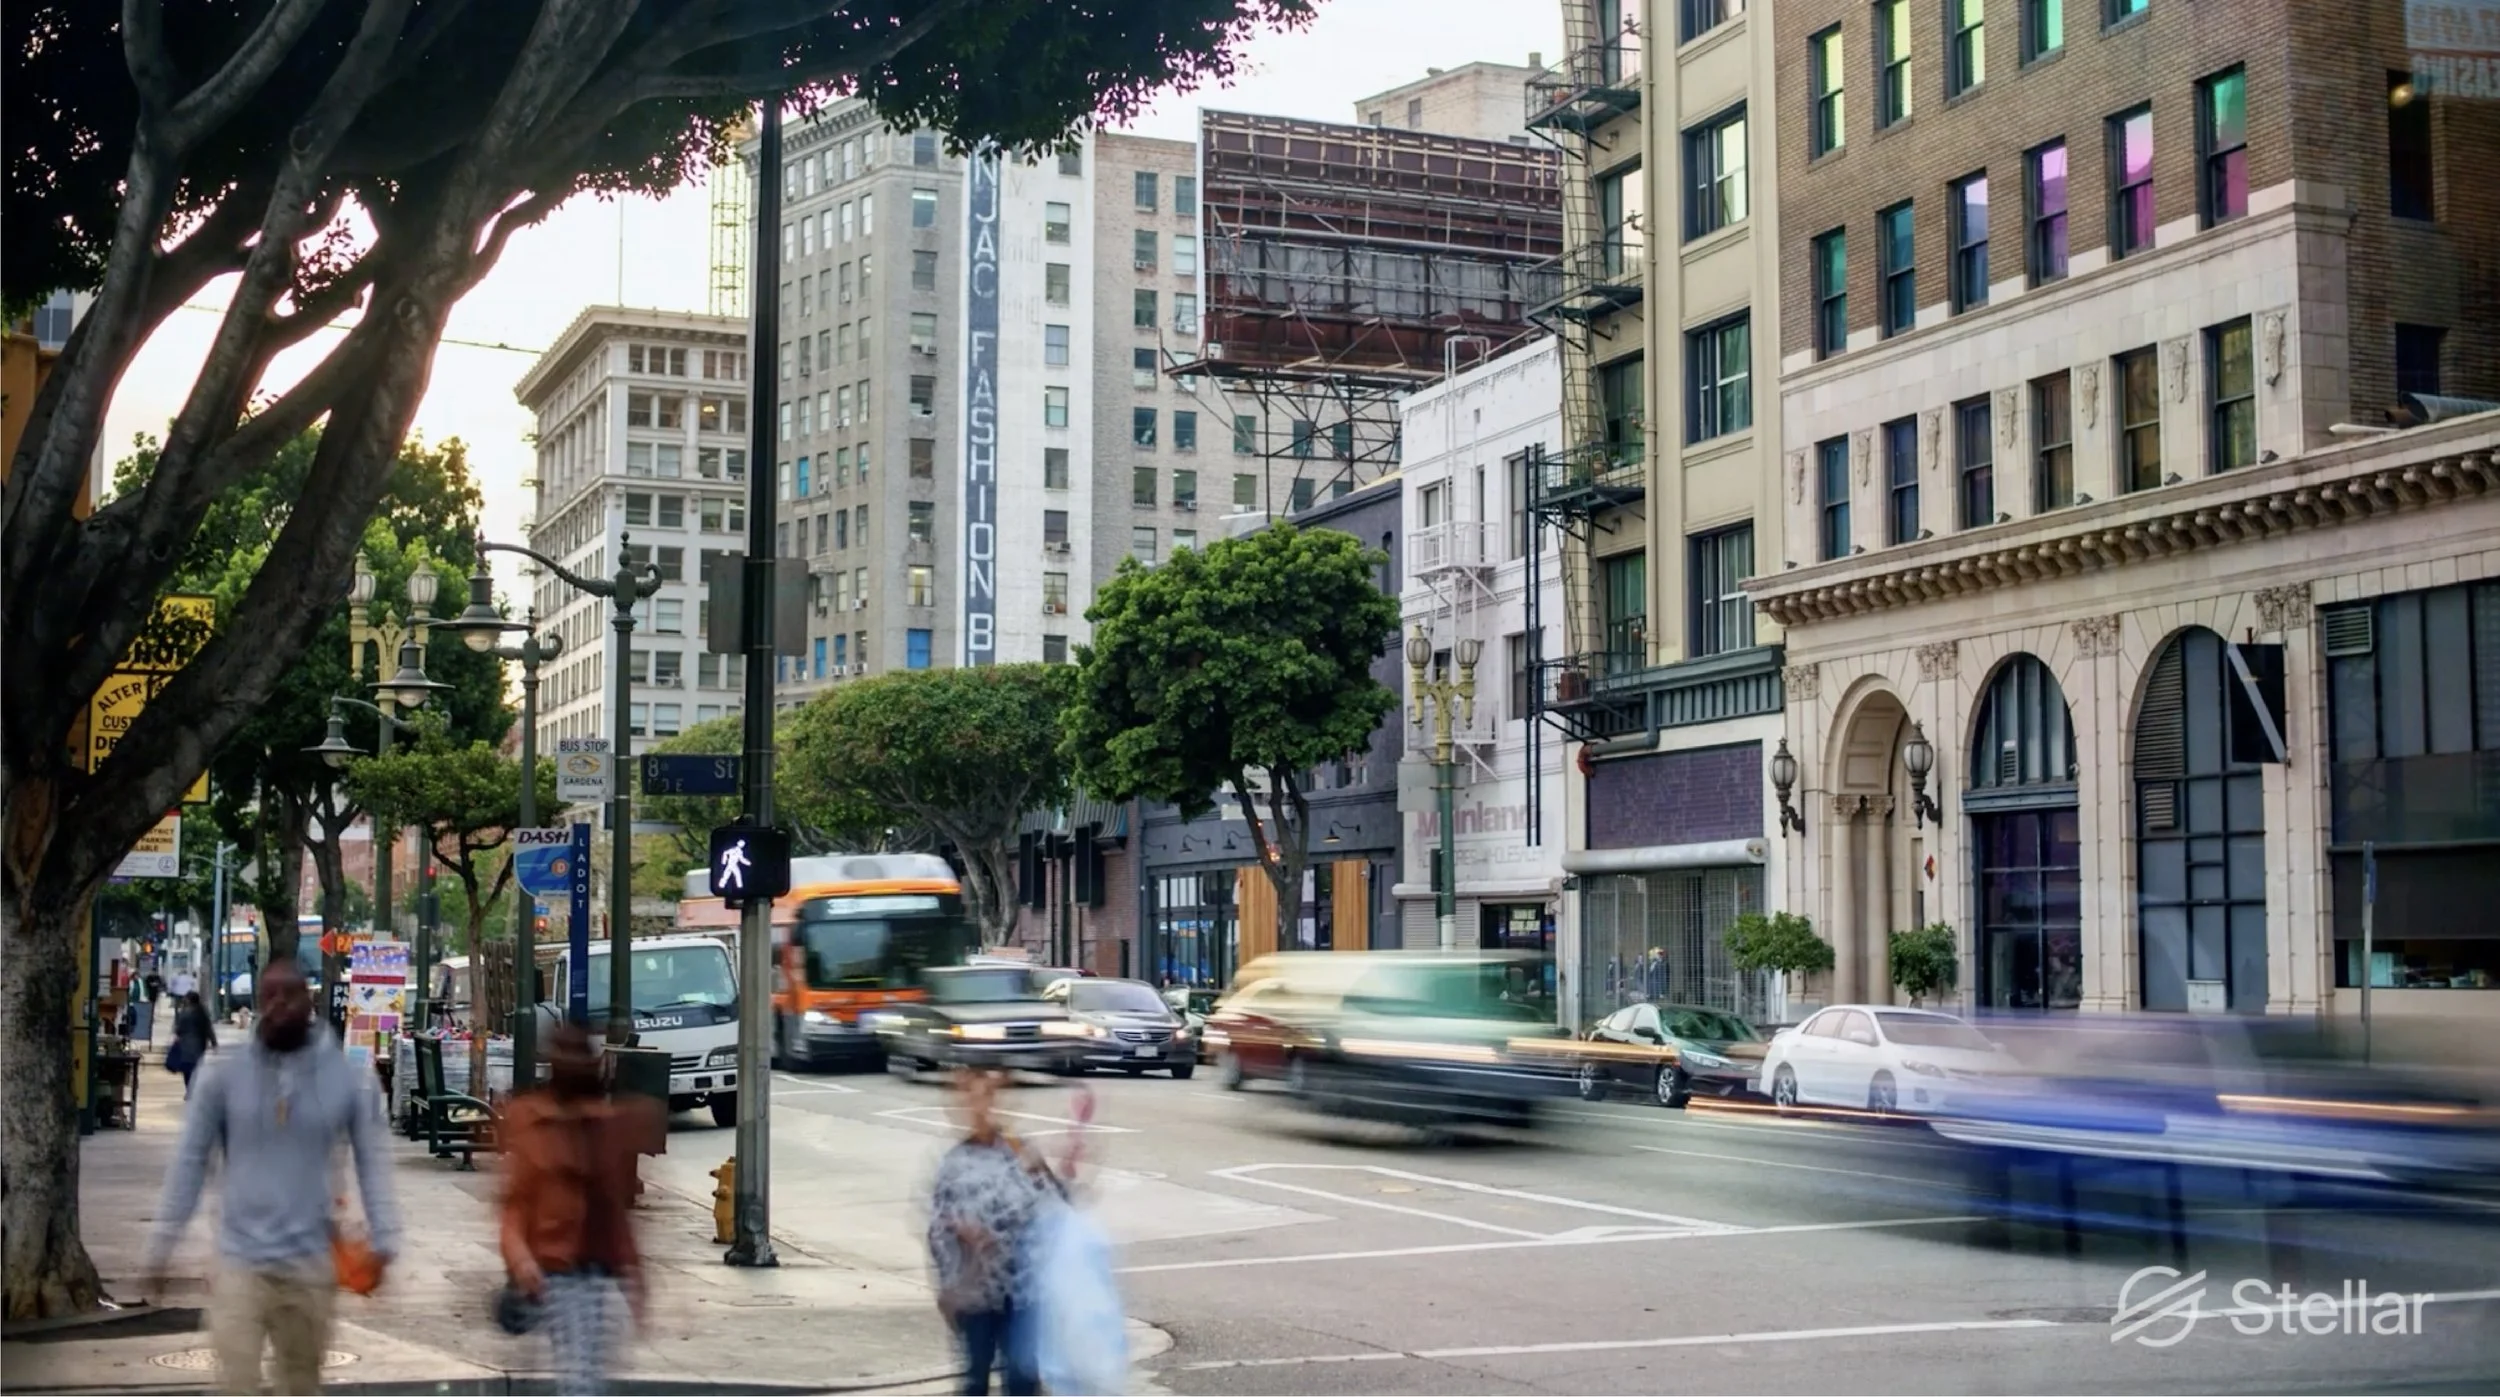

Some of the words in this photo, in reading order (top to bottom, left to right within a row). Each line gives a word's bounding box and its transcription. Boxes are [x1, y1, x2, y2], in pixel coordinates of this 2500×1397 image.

[972, 134, 998, 298] NJAC
[970, 330, 996, 599] FASHION
[103, 715, 133, 729] CUS
[560, 741, 580, 752] BUS
[584, 741, 608, 752] STOP
[714, 757, 735, 779] St
[563, 777, 603, 786] GARDENA
[518, 832, 569, 844] DASH
[576, 838, 587, 909] LADOT
[634, 1016, 683, 1029] ISUZU
